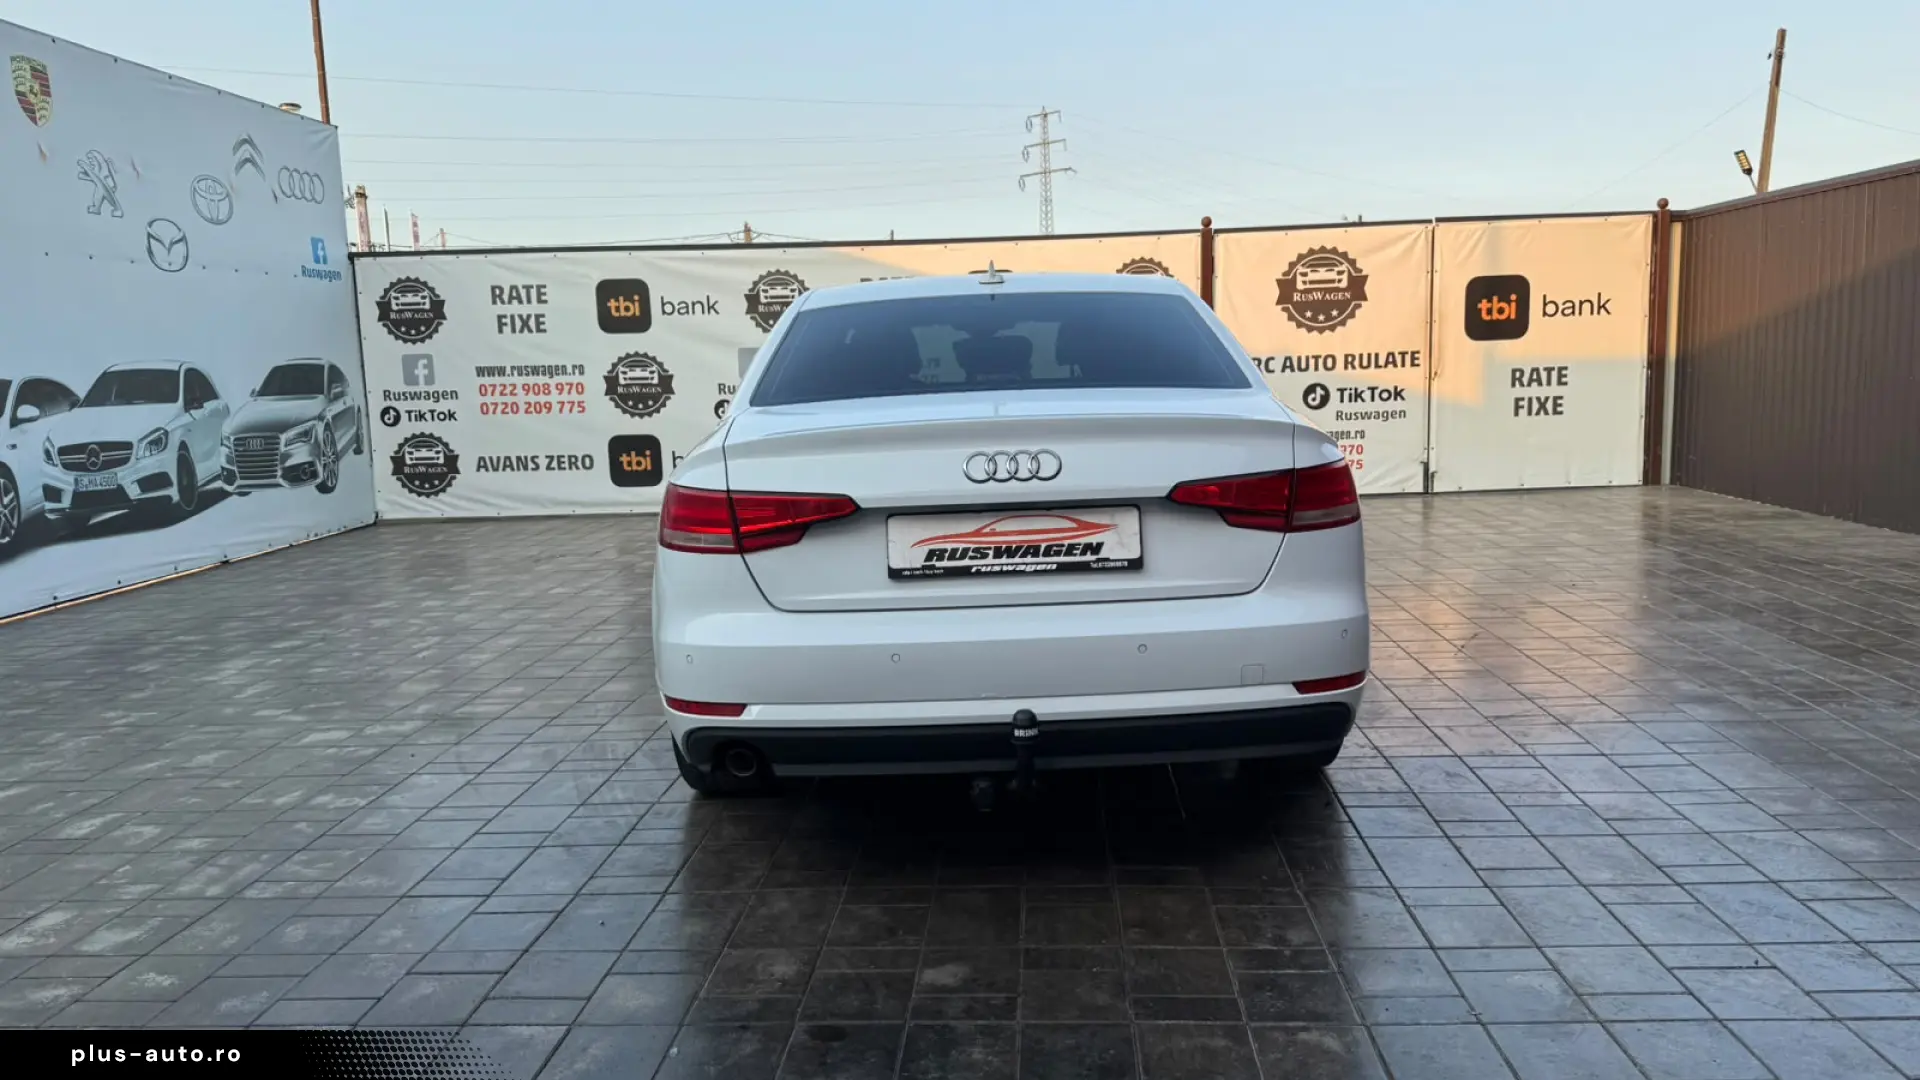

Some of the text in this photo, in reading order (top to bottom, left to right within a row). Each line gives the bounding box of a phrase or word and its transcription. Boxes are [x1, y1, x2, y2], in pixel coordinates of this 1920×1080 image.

[301, 265, 342, 282] Ruswagen
[490, 284, 548, 305] RATE
[607, 295, 720, 317] tbi bank
[1477, 293, 1612, 321] tbi bank
[497, 313, 547, 334] FIXE
[475, 363, 585, 379] www.ruswagen.ro
[1251, 350, 1421, 374] RC AUTO RULATE
[1511, 366, 1569, 387] RATE
[383, 387, 458, 402] Ruswagen
[479, 382, 585, 397] 0722 908 970
[1336, 386, 1406, 404] TikTok
[405, 408, 458, 423] TikTok
[480, 400, 586, 415] 0720 209 775
[1335, 409, 1407, 422] Ruswagen
[1513, 396, 1565, 417] FIXE
[476, 453, 595, 472] AVANS ZERO
[619, 450, 652, 471] tbi
[1348, 459, 1364, 470] 75
[924, 541, 1104, 563] RUSWAGEN
[971, 563, 1057, 573] ruswagen
